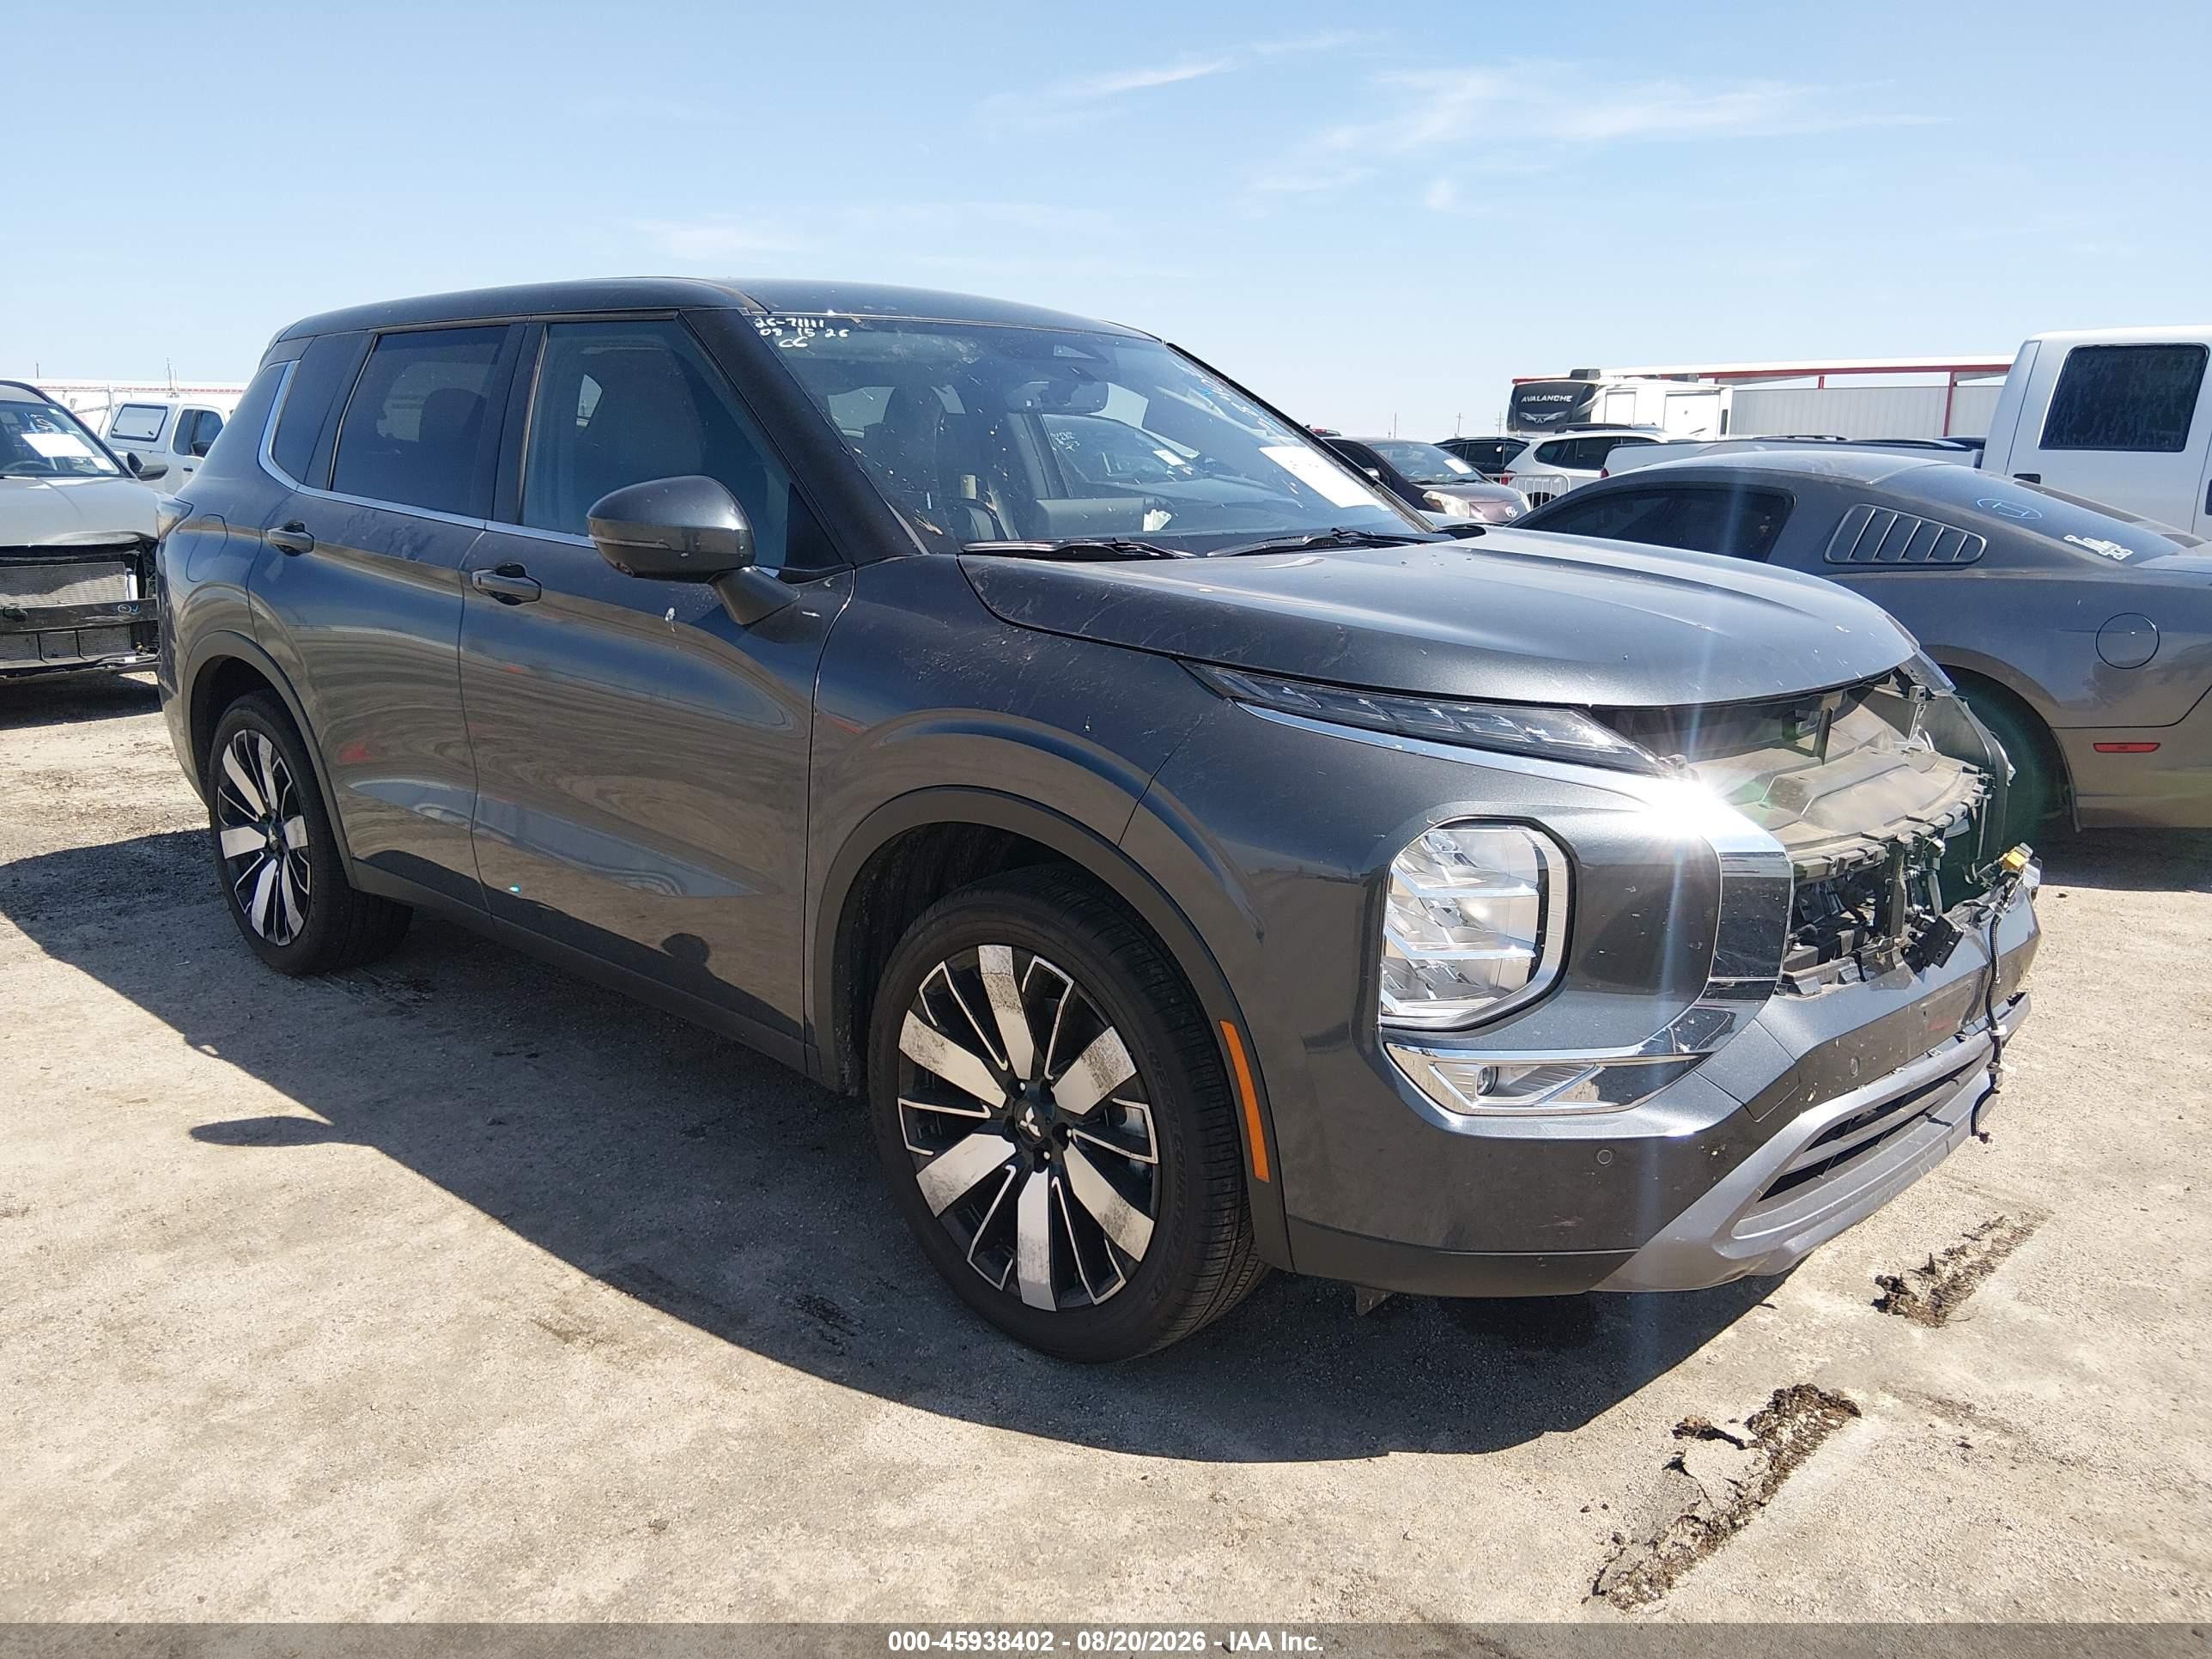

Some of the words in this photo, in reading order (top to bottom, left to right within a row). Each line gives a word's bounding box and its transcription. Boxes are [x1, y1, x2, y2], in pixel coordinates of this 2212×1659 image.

[760, 328, 783, 337] 08
[797, 327, 816, 337] 15
[824, 328, 849, 337] 26
